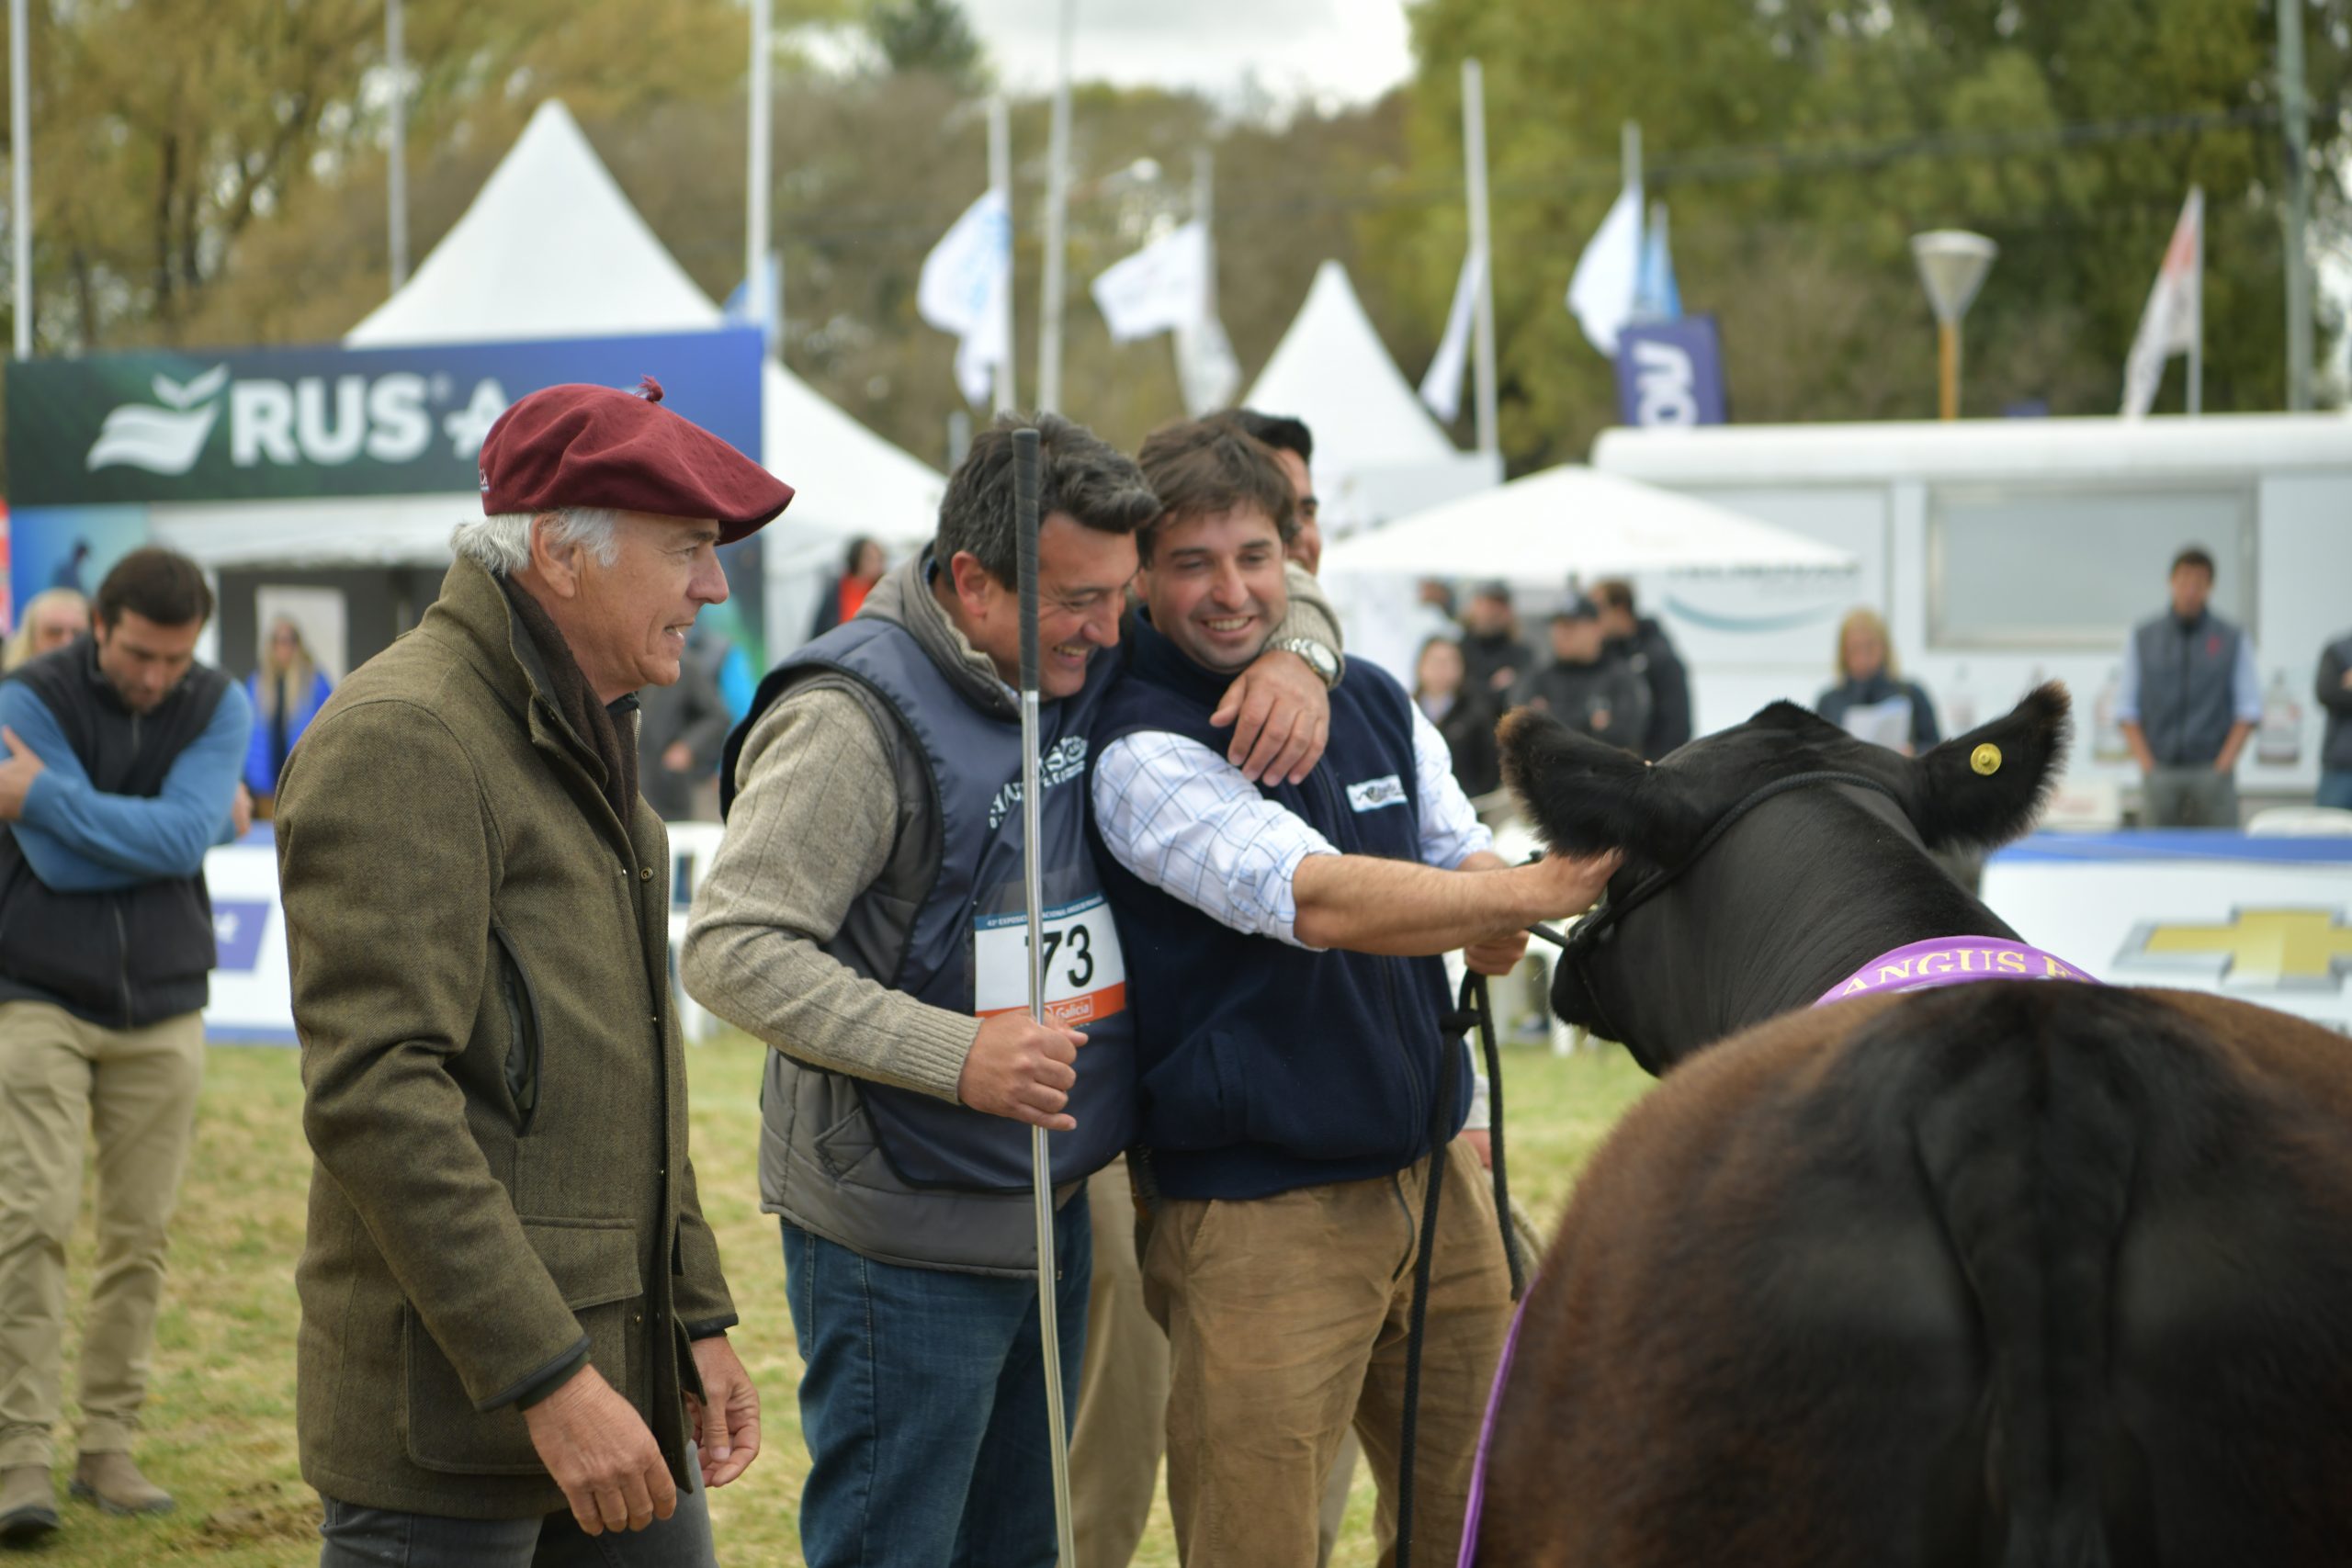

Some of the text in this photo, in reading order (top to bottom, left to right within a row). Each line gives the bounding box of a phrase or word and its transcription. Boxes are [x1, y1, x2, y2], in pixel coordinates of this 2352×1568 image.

[1024, 924, 1094, 988] 73
[1842, 949, 2027, 996] ANGUS
[1056, 1004, 1089, 1018] Galicia
